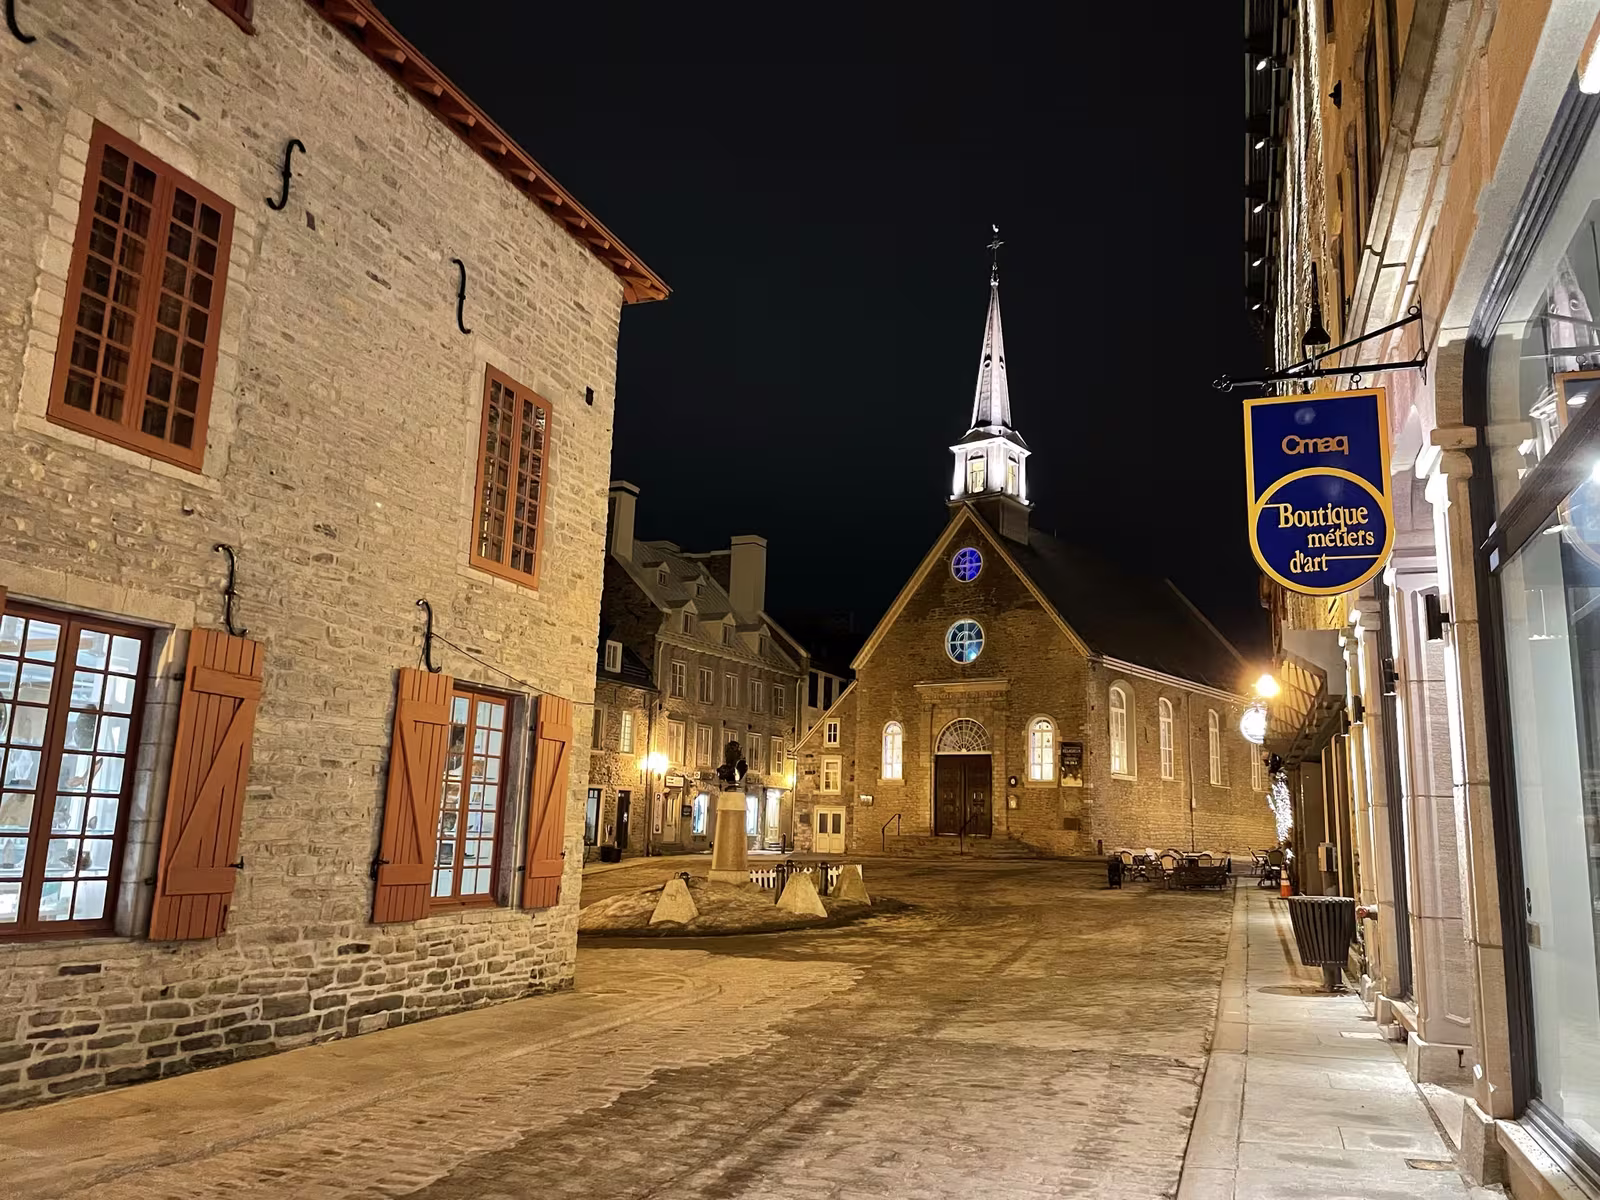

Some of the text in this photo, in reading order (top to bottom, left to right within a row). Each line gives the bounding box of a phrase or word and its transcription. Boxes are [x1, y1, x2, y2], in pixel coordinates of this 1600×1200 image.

[1278, 503, 1368, 532] Boutique
[1307, 528, 1375, 548] métiers
[1290, 550, 1328, 573] d'art
